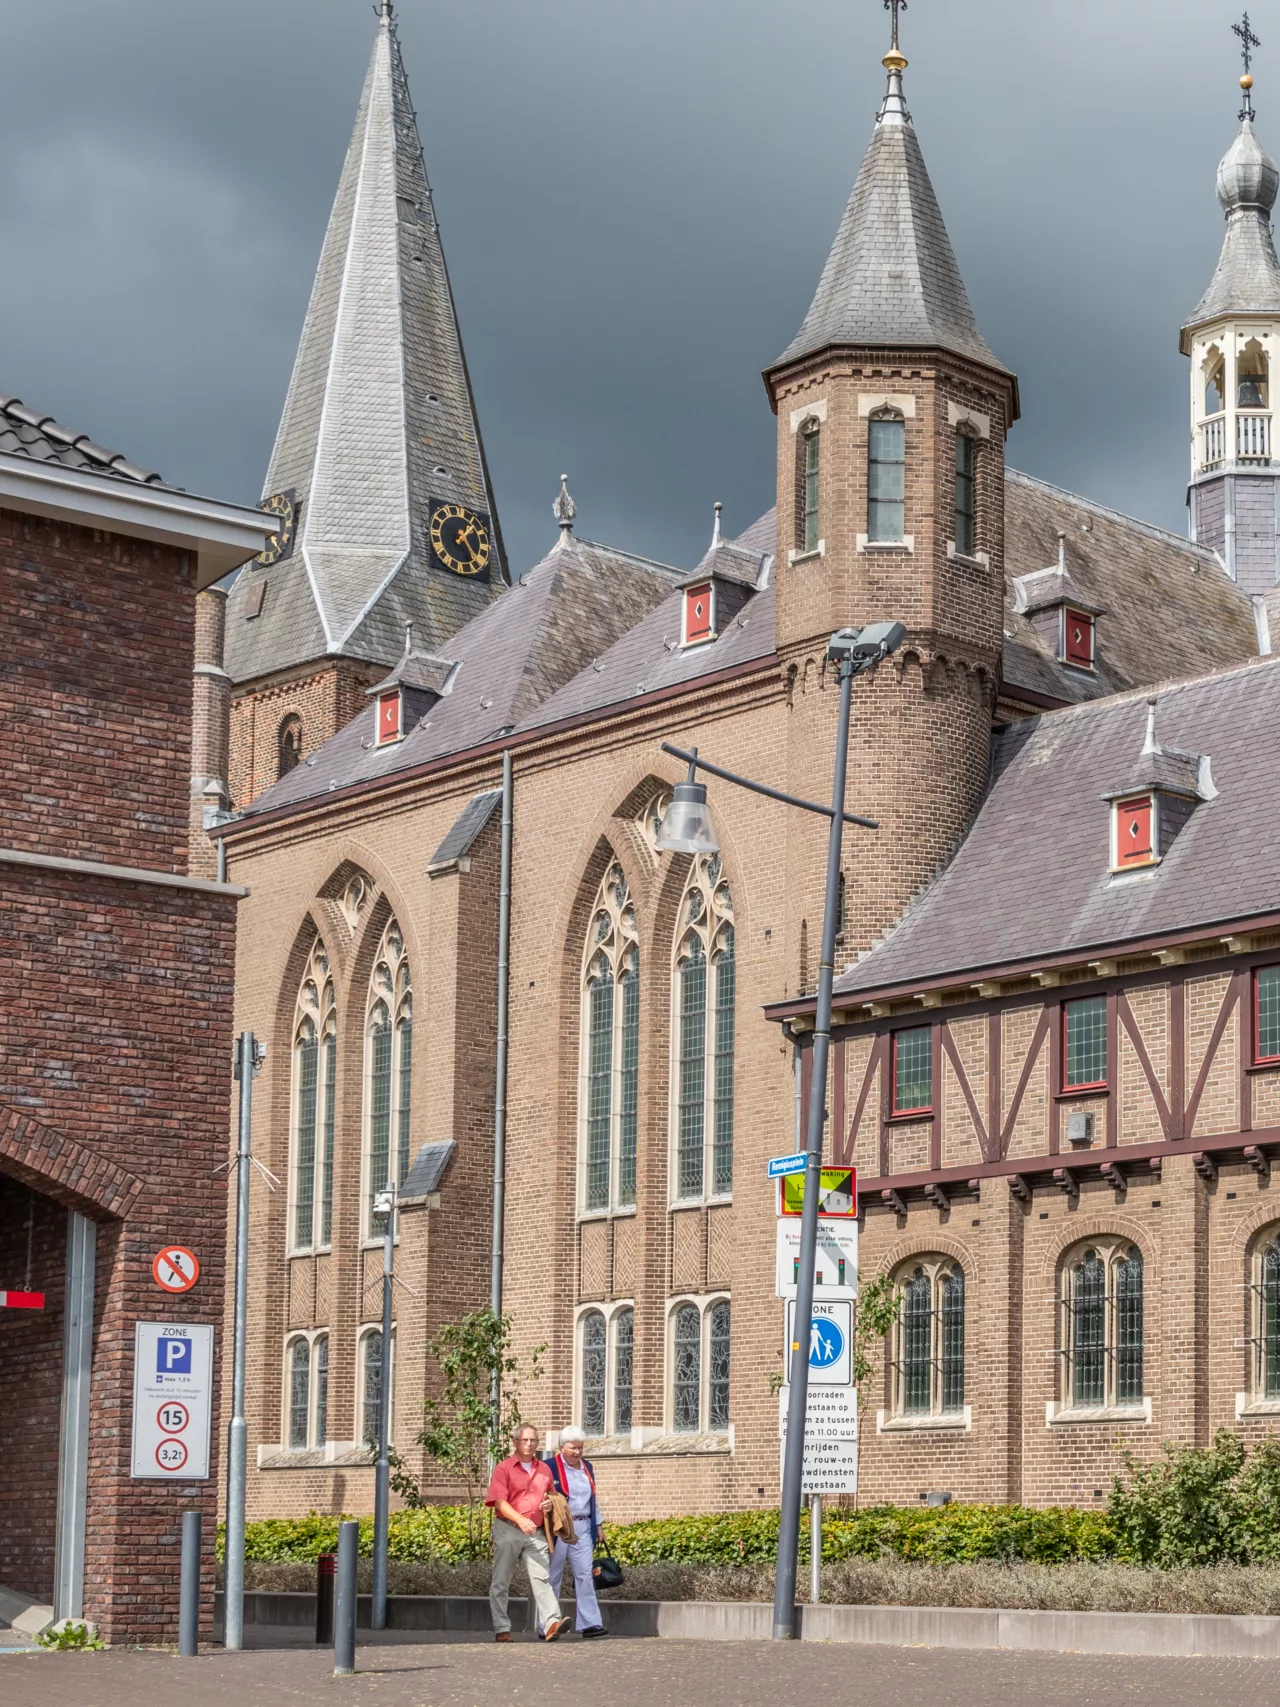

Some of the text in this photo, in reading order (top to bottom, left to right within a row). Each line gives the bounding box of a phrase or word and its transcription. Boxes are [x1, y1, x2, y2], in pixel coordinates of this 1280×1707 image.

[772, 1156, 804, 1171] Remigiusplein
[162, 1328, 188, 1336] ZONE
[166, 1341, 186, 1368] P
[163, 1410, 183, 1425] 15
[805, 1443, 839, 1453] nrijden
[161, 1450, 182, 1461] 3,2t
[803, 1481, 846, 1490] egestaan
